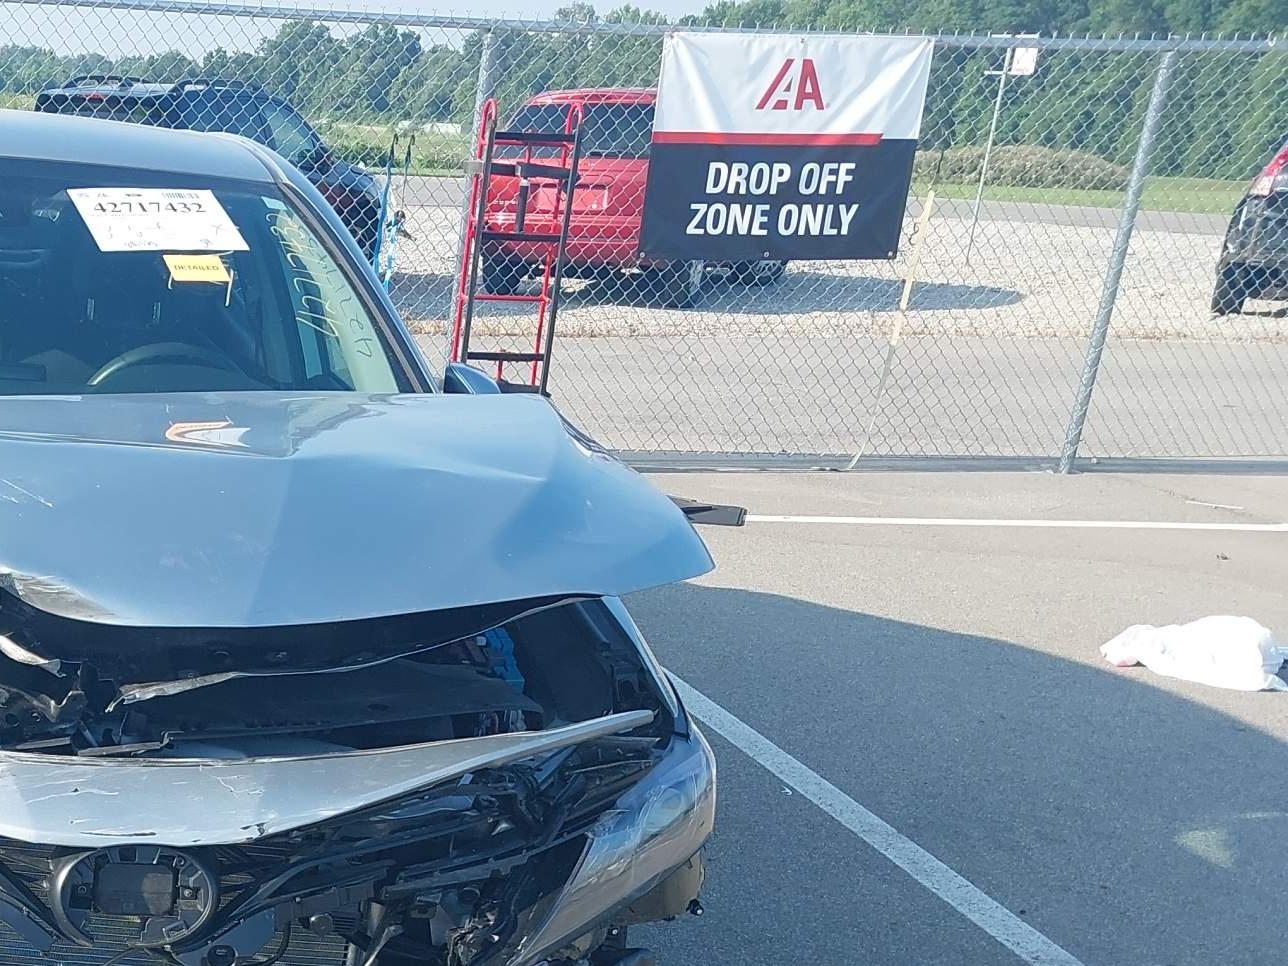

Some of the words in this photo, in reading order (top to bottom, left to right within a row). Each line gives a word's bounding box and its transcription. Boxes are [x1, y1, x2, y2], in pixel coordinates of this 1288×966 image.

[705, 161, 791, 195] DROP
[798, 162, 856, 195] OFF
[93, 201, 208, 214] 42717432
[685, 203, 771, 236] ZONE
[777, 203, 859, 236] ONLY
